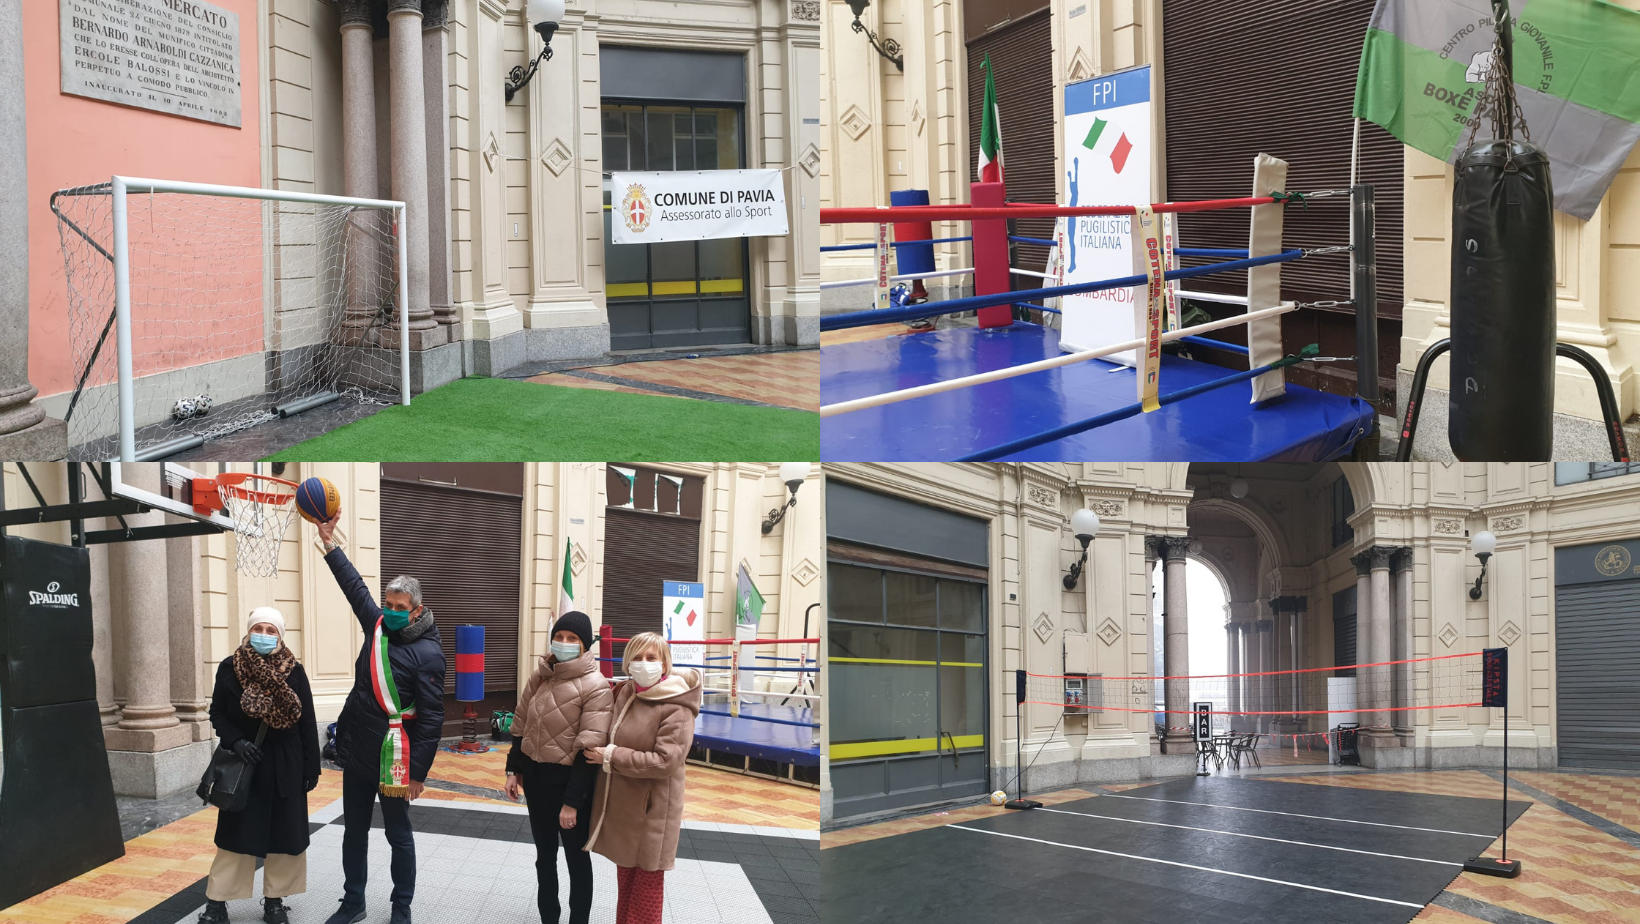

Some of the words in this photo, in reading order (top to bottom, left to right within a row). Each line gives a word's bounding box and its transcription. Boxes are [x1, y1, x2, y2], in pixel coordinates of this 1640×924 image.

[162, 0, 226, 28] MERCATO
[178, 17, 193, 28] DEL
[72, 16, 128, 42] BERNARDO
[133, 35, 186, 59] ARNABOLDI
[74, 4, 95, 17] DAL
[102, 13, 128, 28] NOME
[135, 24, 152, 35] DEL
[159, 32, 196, 48] MUNIFICO
[199, 44, 233, 60] CITTADINO
[130, 11, 140, 20] 24
[194, 32, 232, 50] INTITOLATO
[74, 34, 92, 44] CHE
[96, 39, 106, 48] LO
[110, 44, 138, 56] ERESSE
[1440, 24, 1475, 60] CENTRO
[1478, 18, 1516, 28] PILA
[1520, 22, 1554, 70] GIOVANILE
[74, 46, 120, 64] ERCOLE
[128, 60, 170, 77] BALOSSI
[75, 60, 120, 76] PERPETUO
[138, 76, 171, 88] COMODO
[1093, 80, 1116, 105] FPI
[179, 102, 204, 111] APRILE
[1424, 82, 1472, 111] BOXE
[1473, 102, 1527, 130] PAA
[654, 192, 715, 206] COMUNE
[720, 191, 733, 204] DI
[738, 190, 775, 203] PAVIA
[661, 209, 721, 221] Assessorato
[725, 206, 741, 218] allo
[745, 206, 772, 219] Sport
[1081, 220, 1131, 234] PUGILISTIC
[1080, 235, 1122, 249] ITALIANA
[1146, 238, 1162, 298] COTENA
[1068, 282, 1134, 304] MBARDI
[1149, 309, 1160, 358] SPORT
[29, 591, 77, 606] SPALDING
[678, 585, 690, 595] FPI
